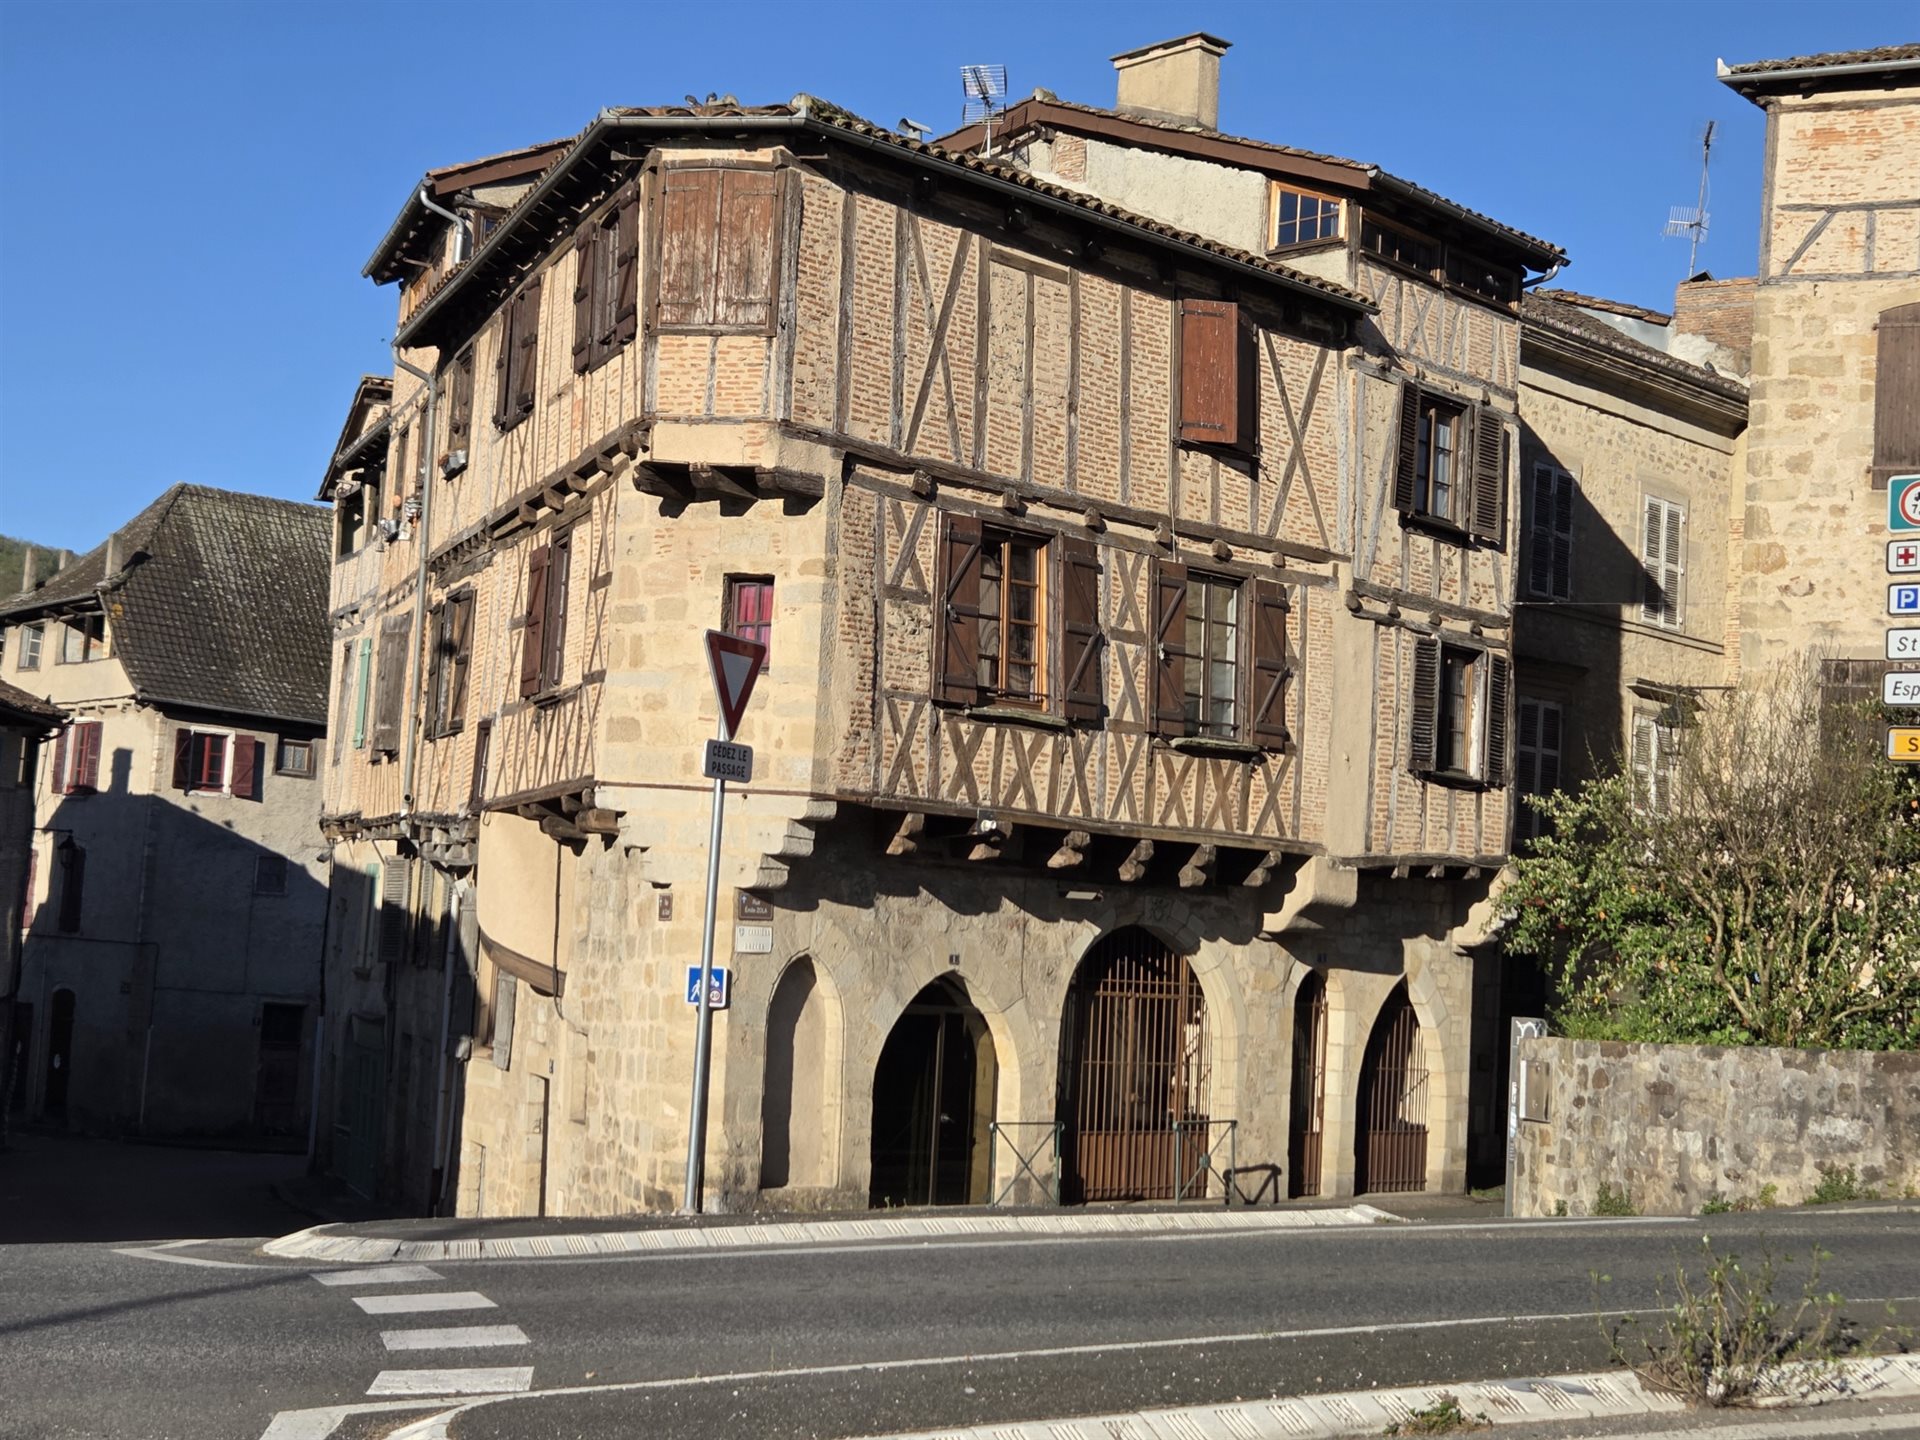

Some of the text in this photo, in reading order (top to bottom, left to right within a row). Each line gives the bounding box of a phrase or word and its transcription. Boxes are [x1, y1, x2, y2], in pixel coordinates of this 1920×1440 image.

[1900, 590, 1915, 608] P
[1892, 680, 1920, 700] Esp
[712, 743, 748, 762] CÉDEZ LE
[711, 761, 746, 778] PASSAGE
